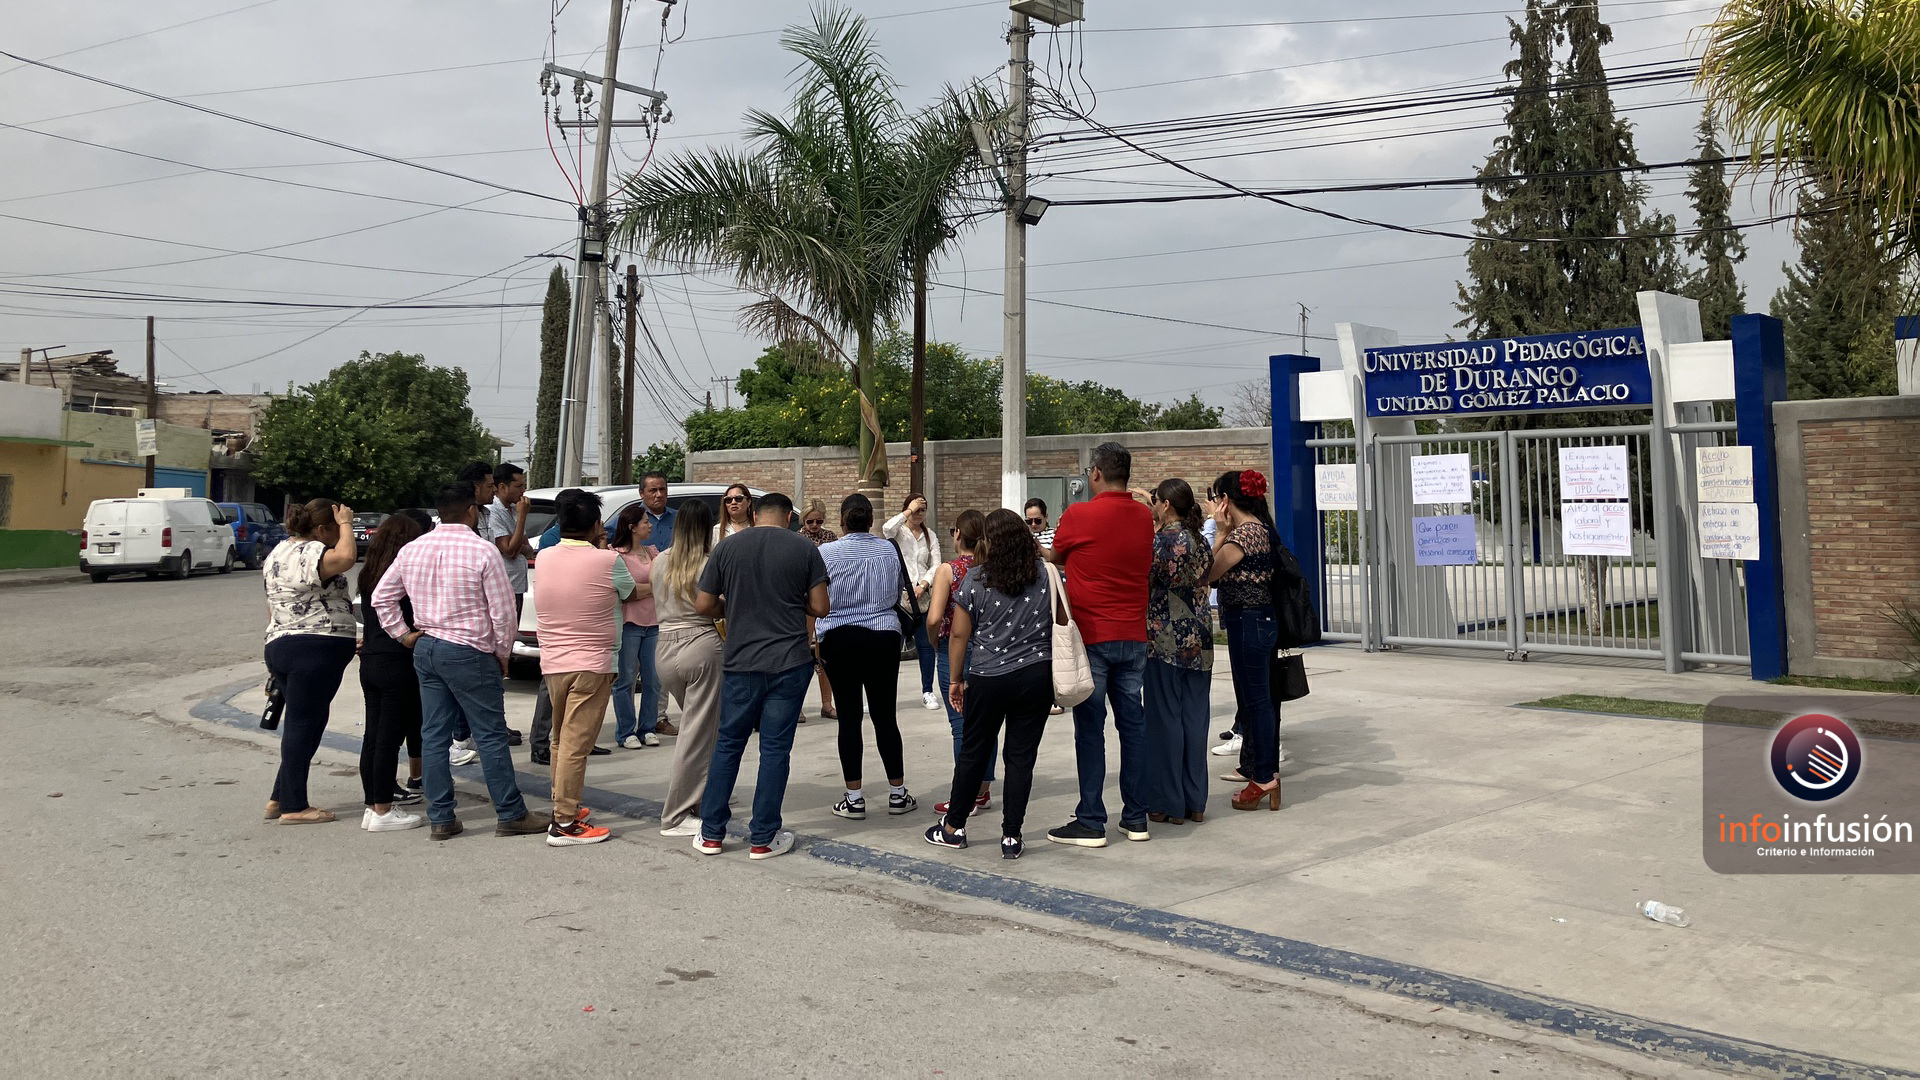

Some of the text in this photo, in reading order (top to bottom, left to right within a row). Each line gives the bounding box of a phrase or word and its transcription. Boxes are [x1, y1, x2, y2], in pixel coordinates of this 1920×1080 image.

[1363, 334, 1643, 373] UNIVERSIDAD PEDAGÓGICA
[1420, 365, 1578, 393] DE DURANGO
[1376, 383, 1630, 412] UNIDAD GÓMEZ PALACIO
[1575, 486, 1592, 494] UPD
[1575, 515, 1601, 524] laboral
